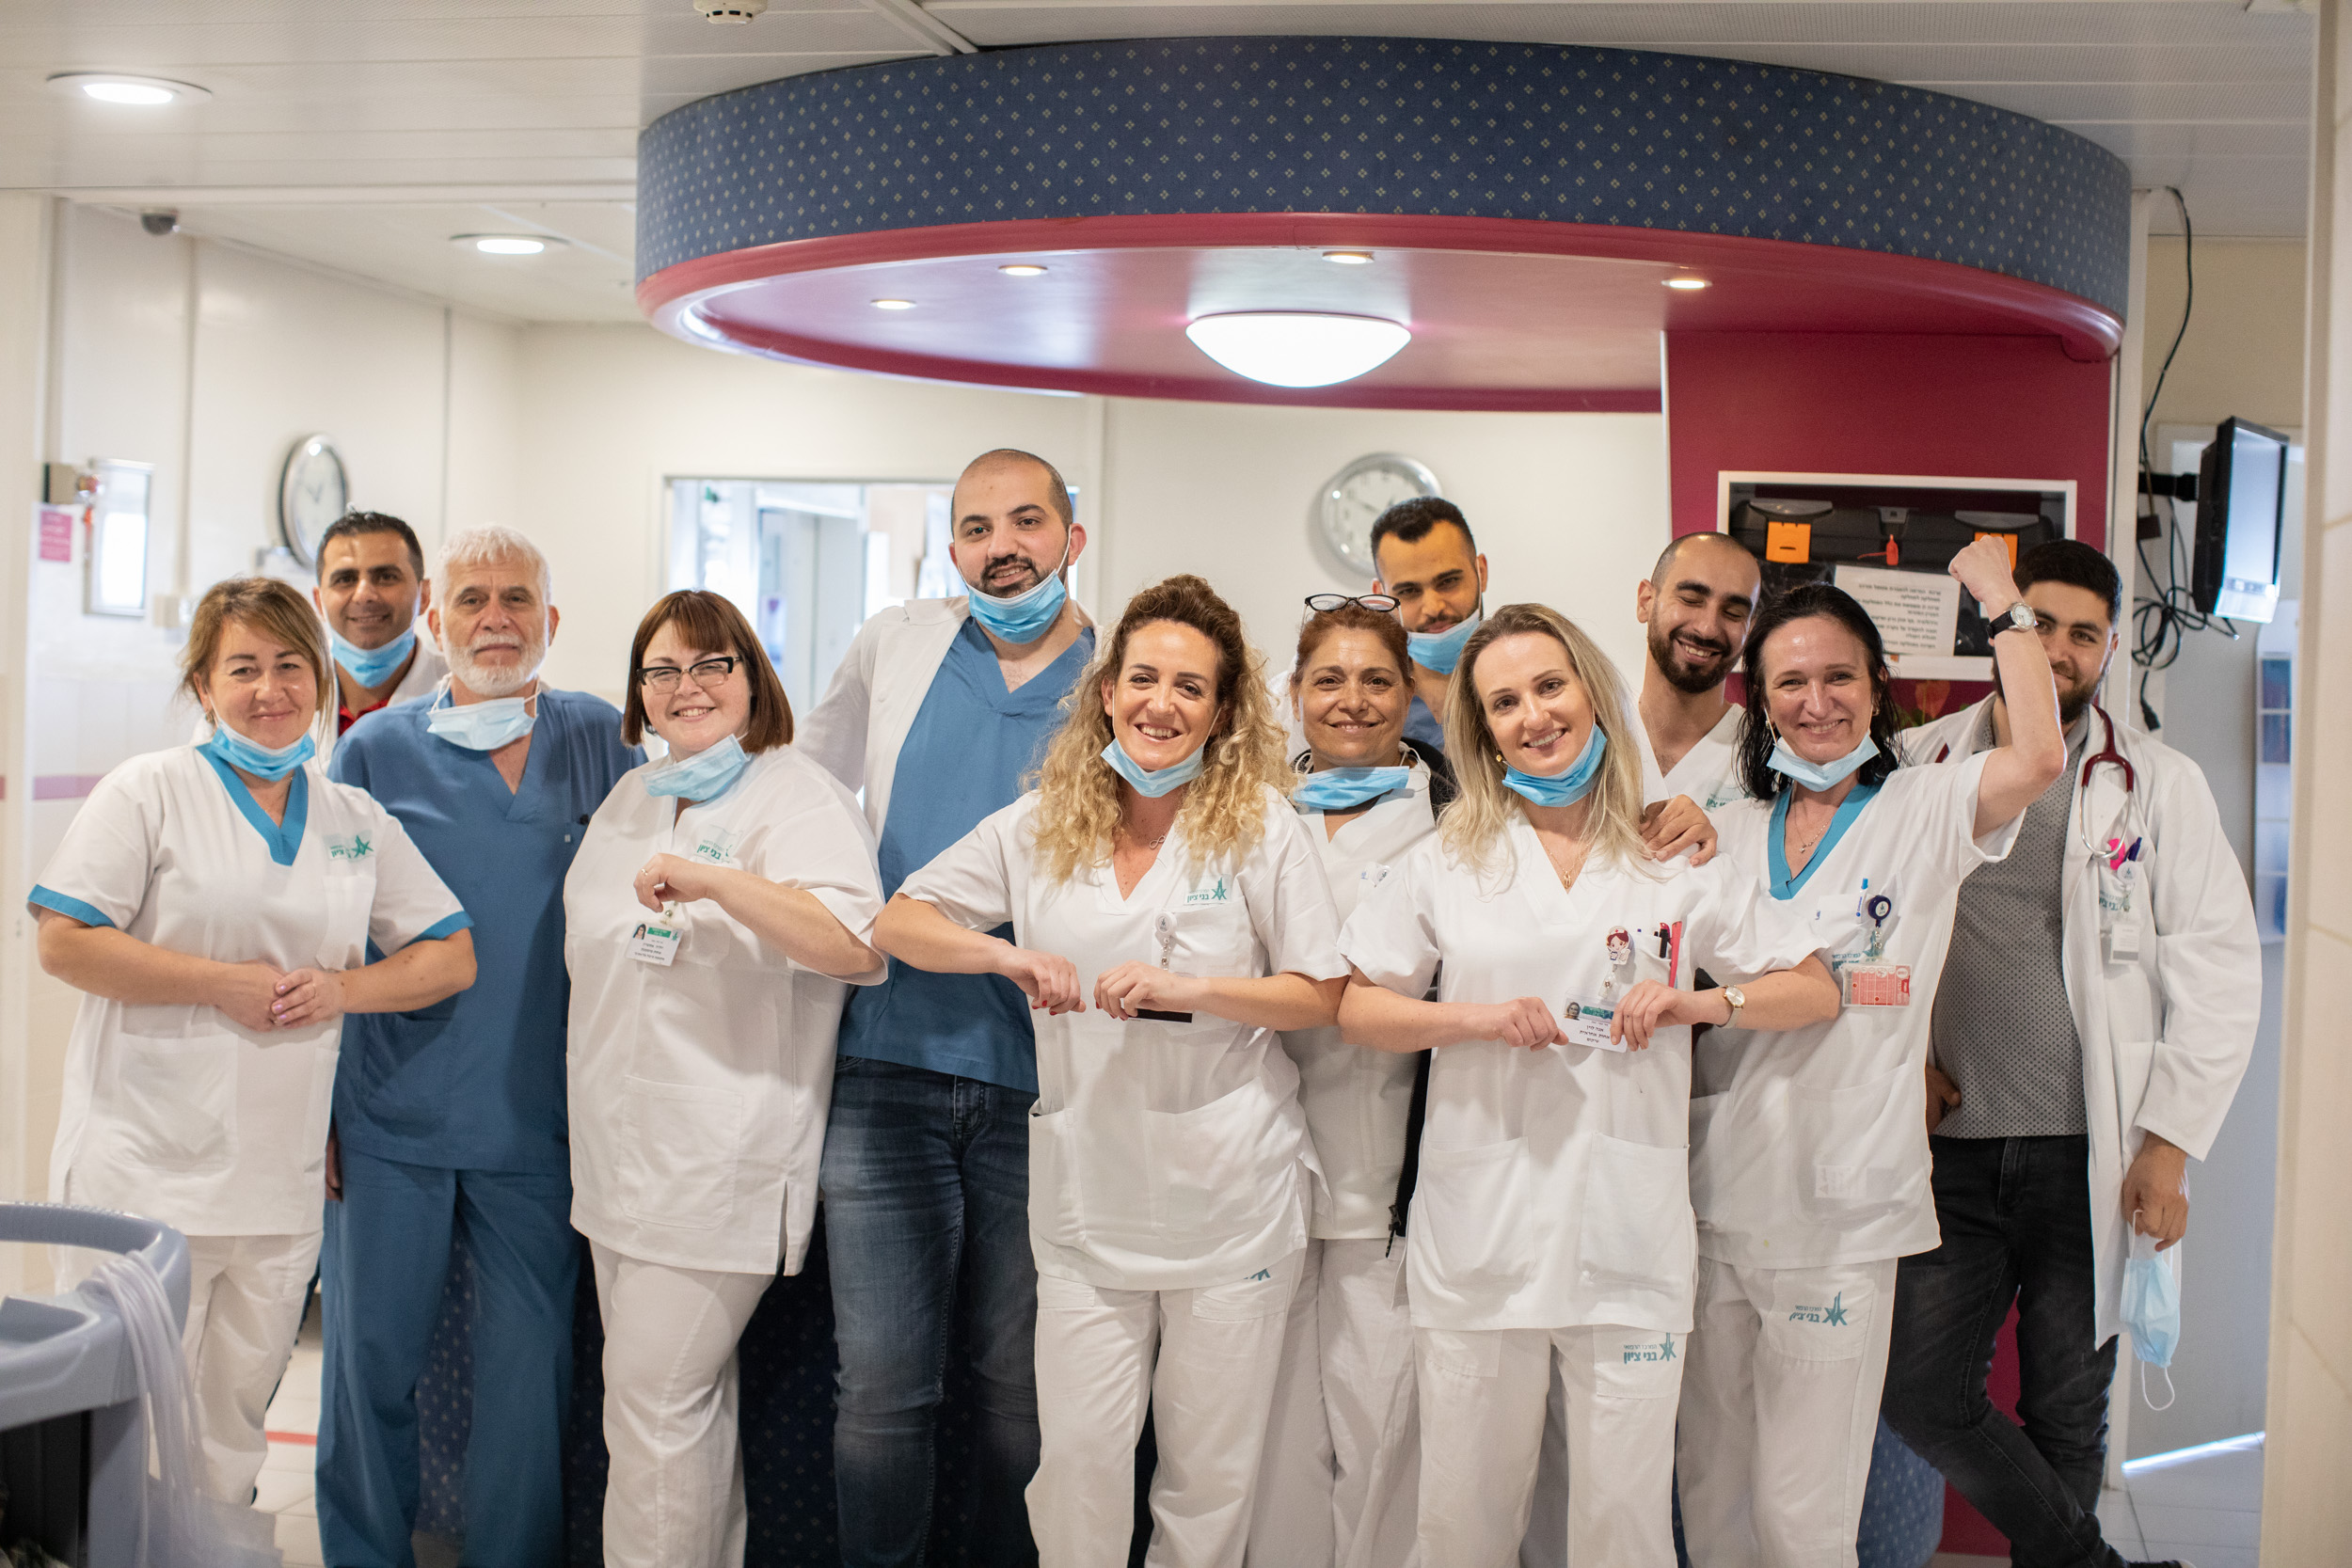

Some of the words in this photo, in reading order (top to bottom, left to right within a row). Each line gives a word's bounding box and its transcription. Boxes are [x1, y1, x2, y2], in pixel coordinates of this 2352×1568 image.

[696, 844, 710, 853] ציון
[710, 848, 722, 860] בני
[1186, 895, 1199, 903] ציון
[1788, 1311, 1806, 1322] ציון
[1805, 1312, 1820, 1323] בני
[1623, 1352, 1642, 1365] ציון
[1643, 1352, 1658, 1362] בני
